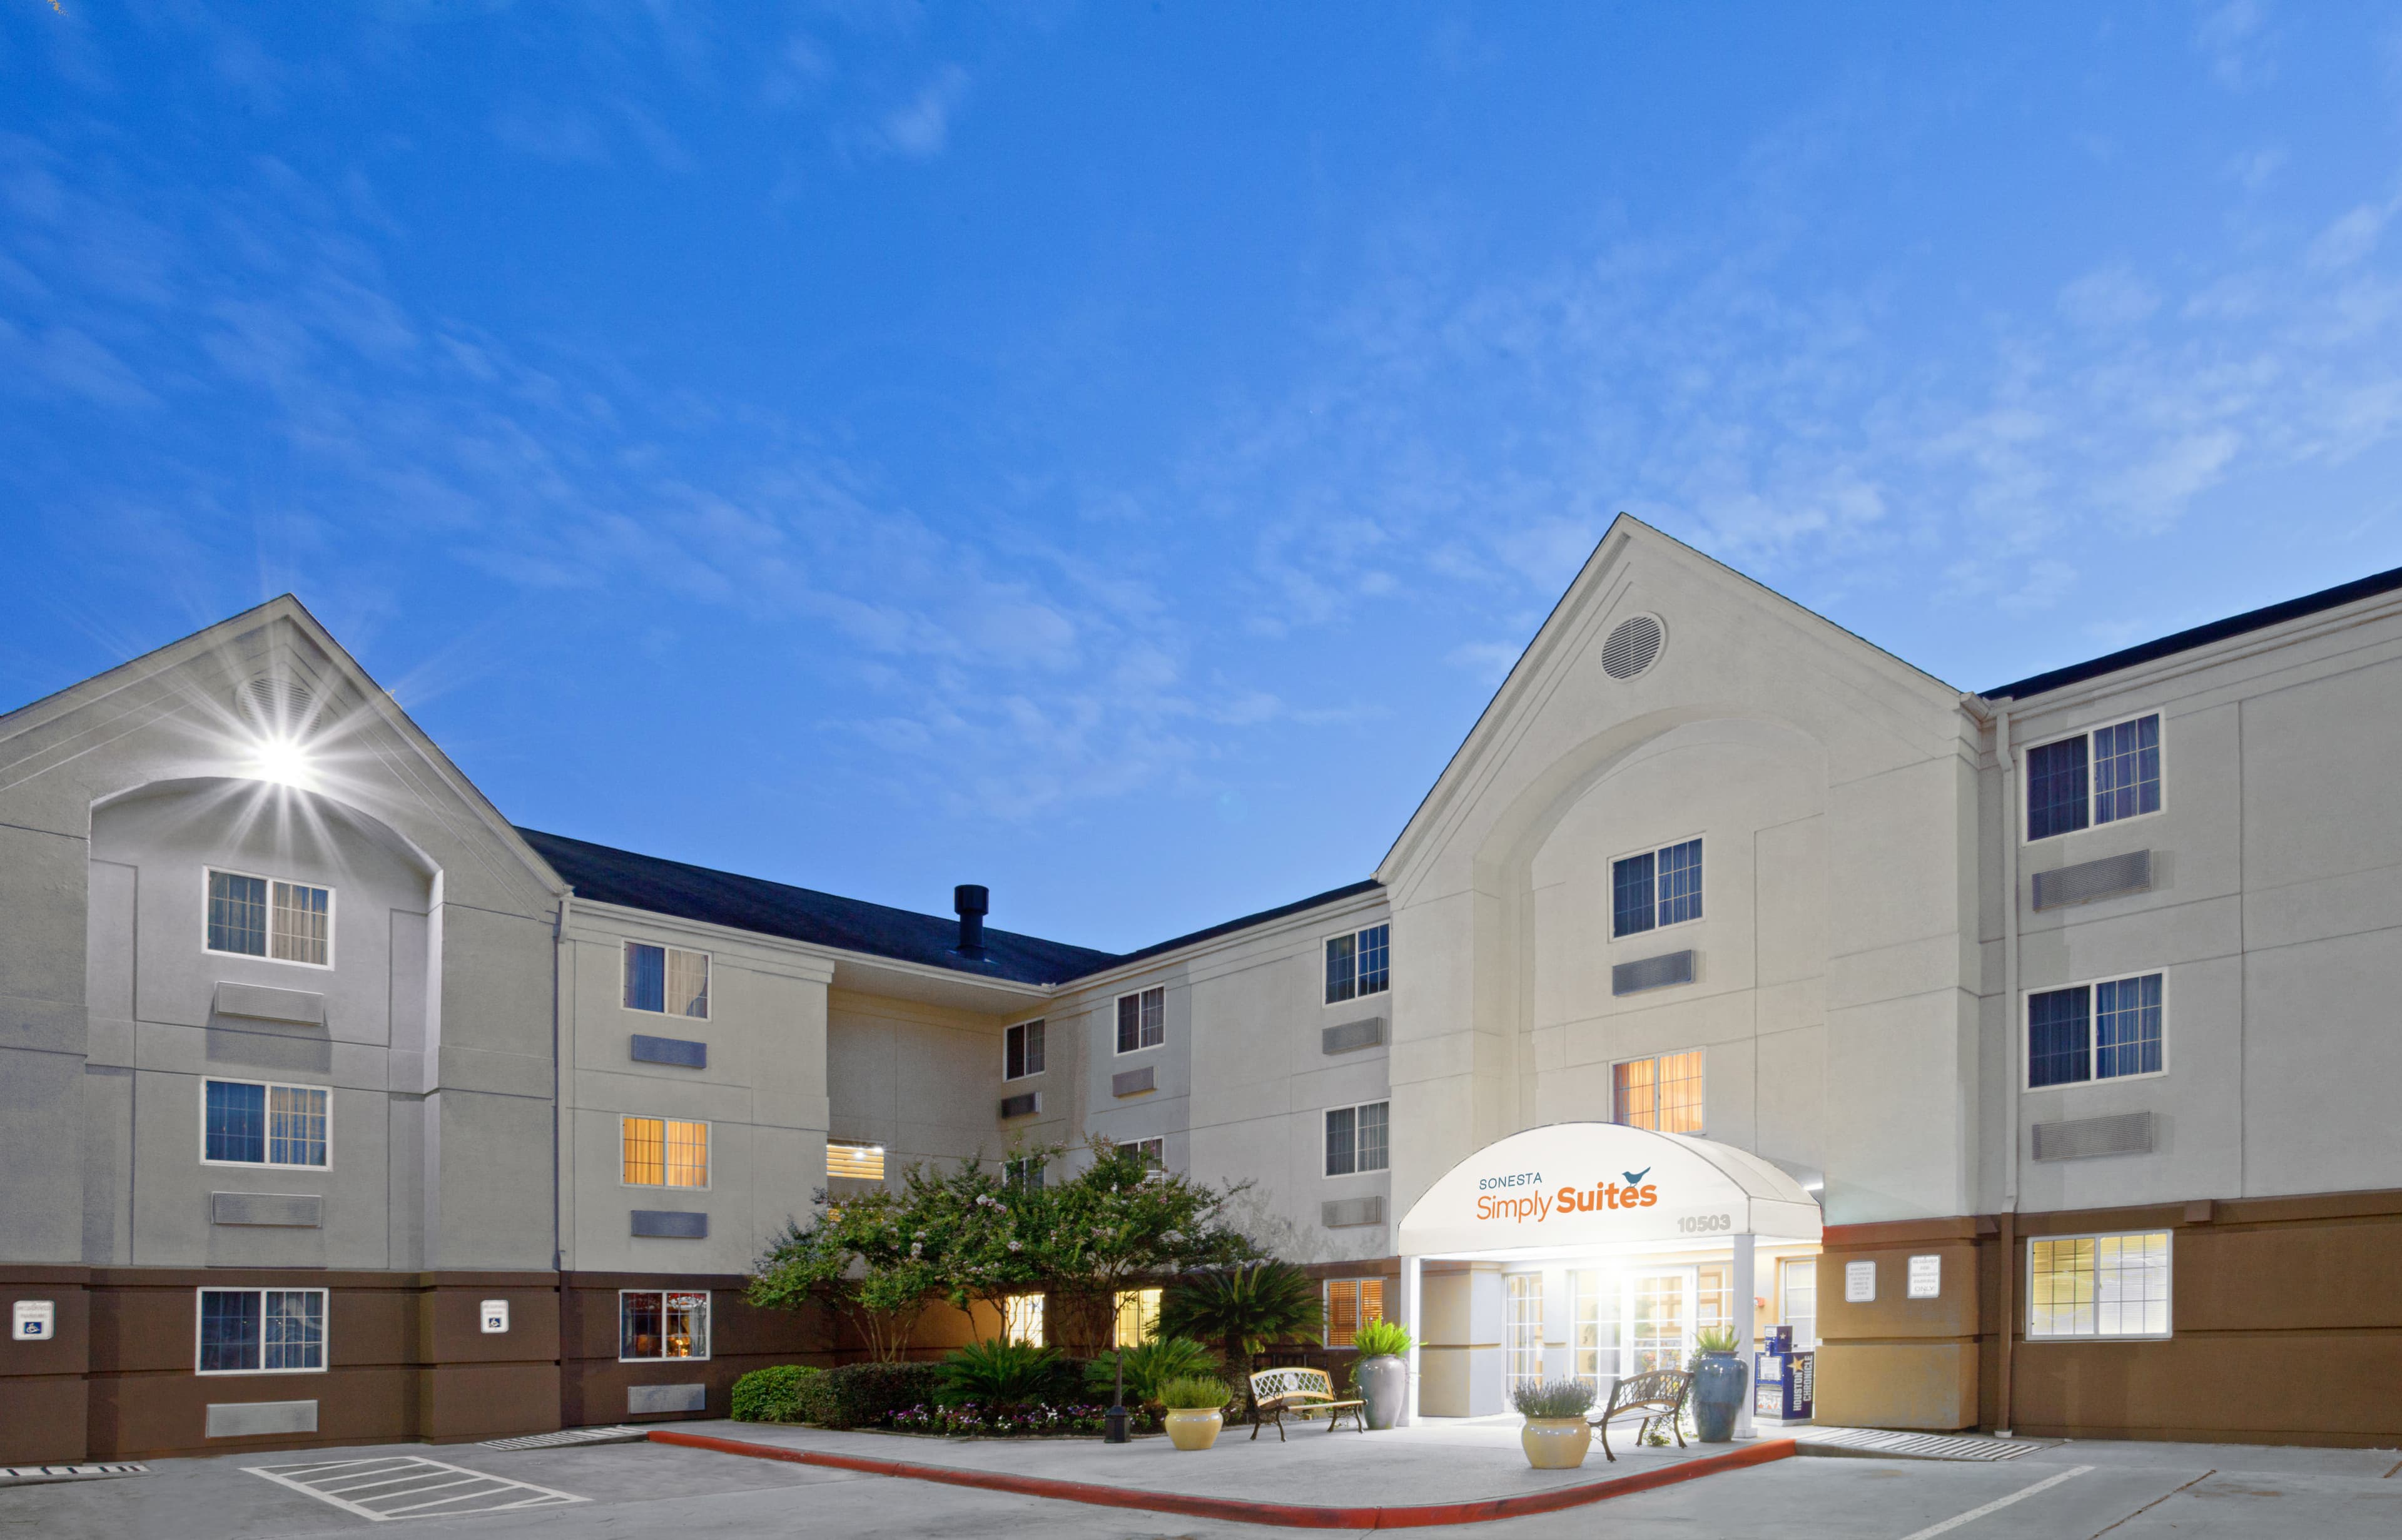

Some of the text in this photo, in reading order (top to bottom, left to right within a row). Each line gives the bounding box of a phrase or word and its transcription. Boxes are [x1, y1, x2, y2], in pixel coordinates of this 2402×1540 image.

[1479, 1172, 1543, 1190] SONESTA
[1476, 1181, 1658, 1224] Simply Suites
[1677, 1213, 1731, 1233] 10503
[1793, 1371, 1803, 1412] HOUSTON
[1803, 1355, 1813, 1402] CHRONICLE
